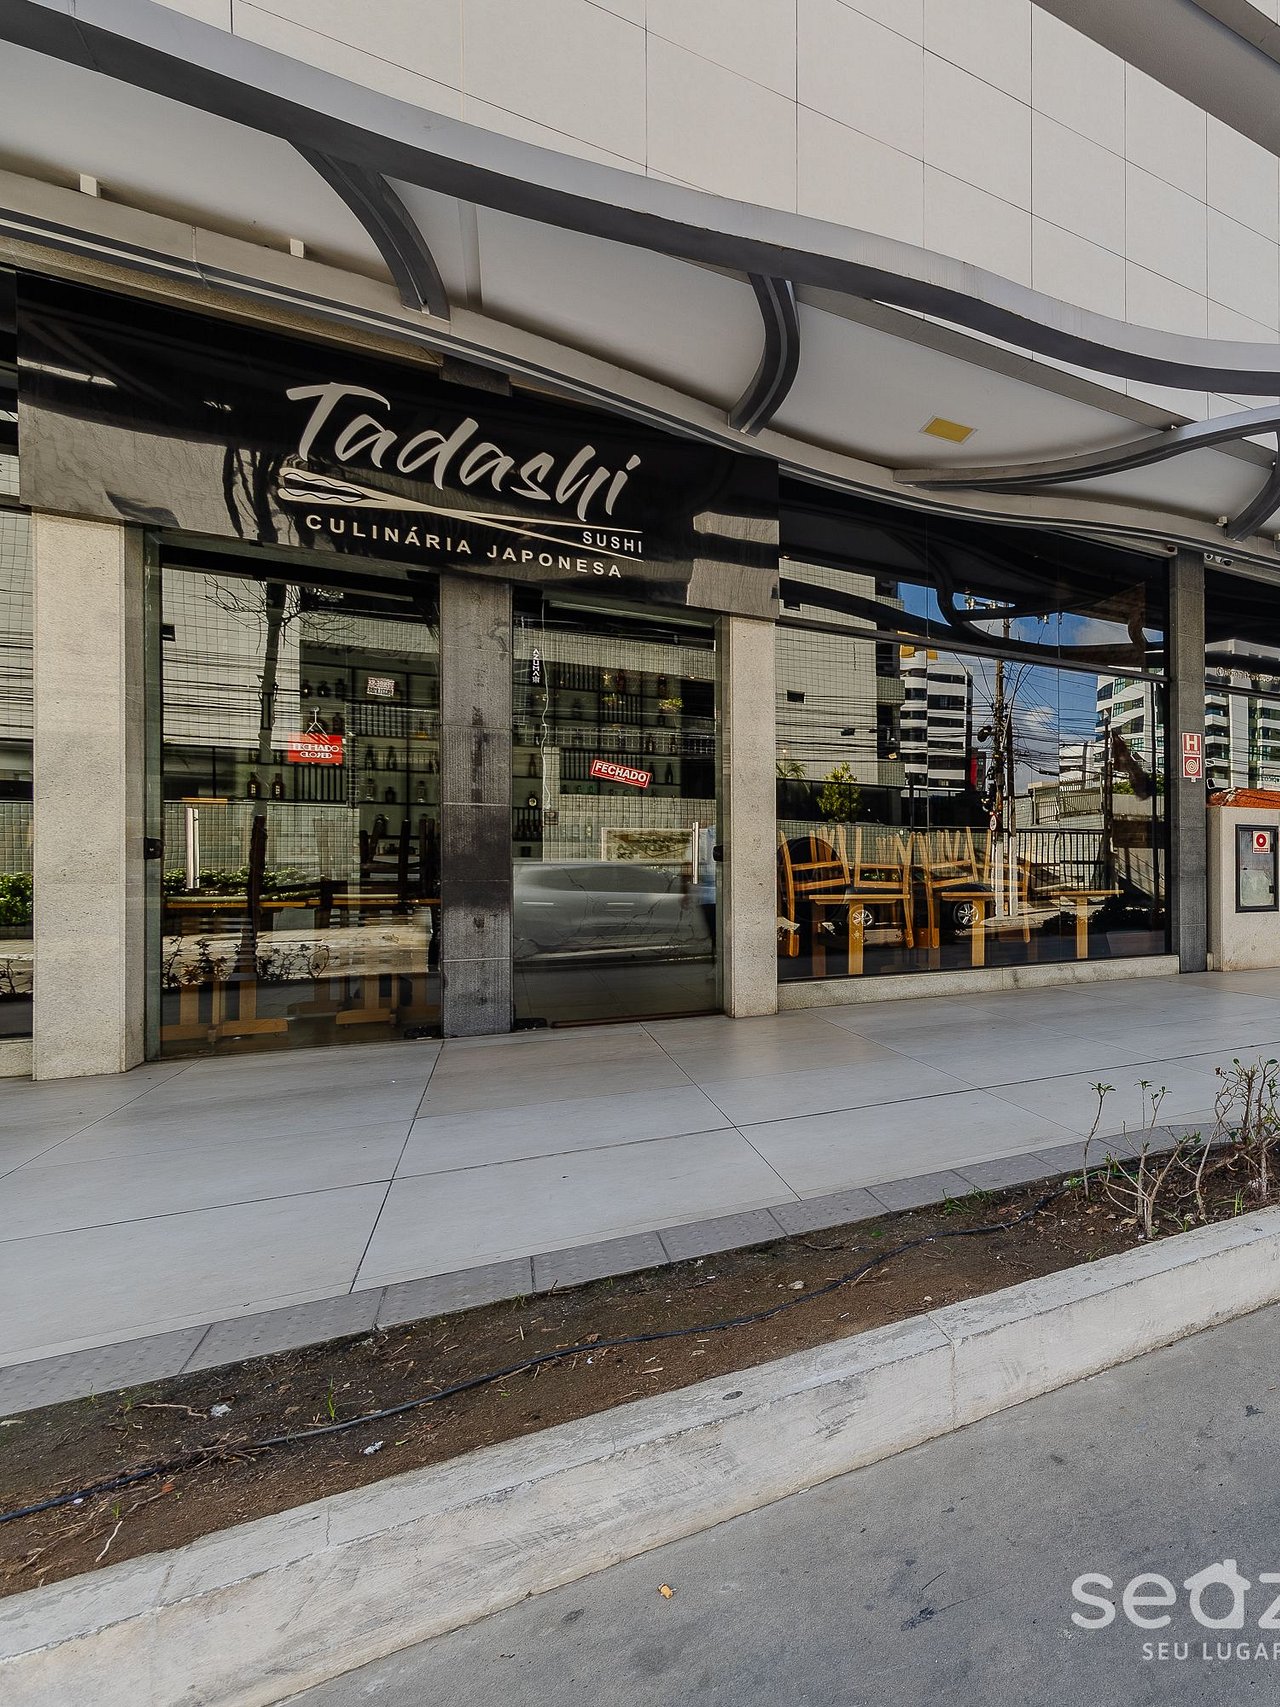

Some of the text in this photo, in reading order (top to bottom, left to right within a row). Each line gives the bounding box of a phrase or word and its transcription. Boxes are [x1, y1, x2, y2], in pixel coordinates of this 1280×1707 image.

[286, 382, 641, 522] Tadashi
[305, 514, 622, 578] CULINÁRIA JAPONESA
[582, 531, 643, 553] SUSHI
[1186, 734, 1198, 751] H
[594, 762, 647, 782] FECHADO
